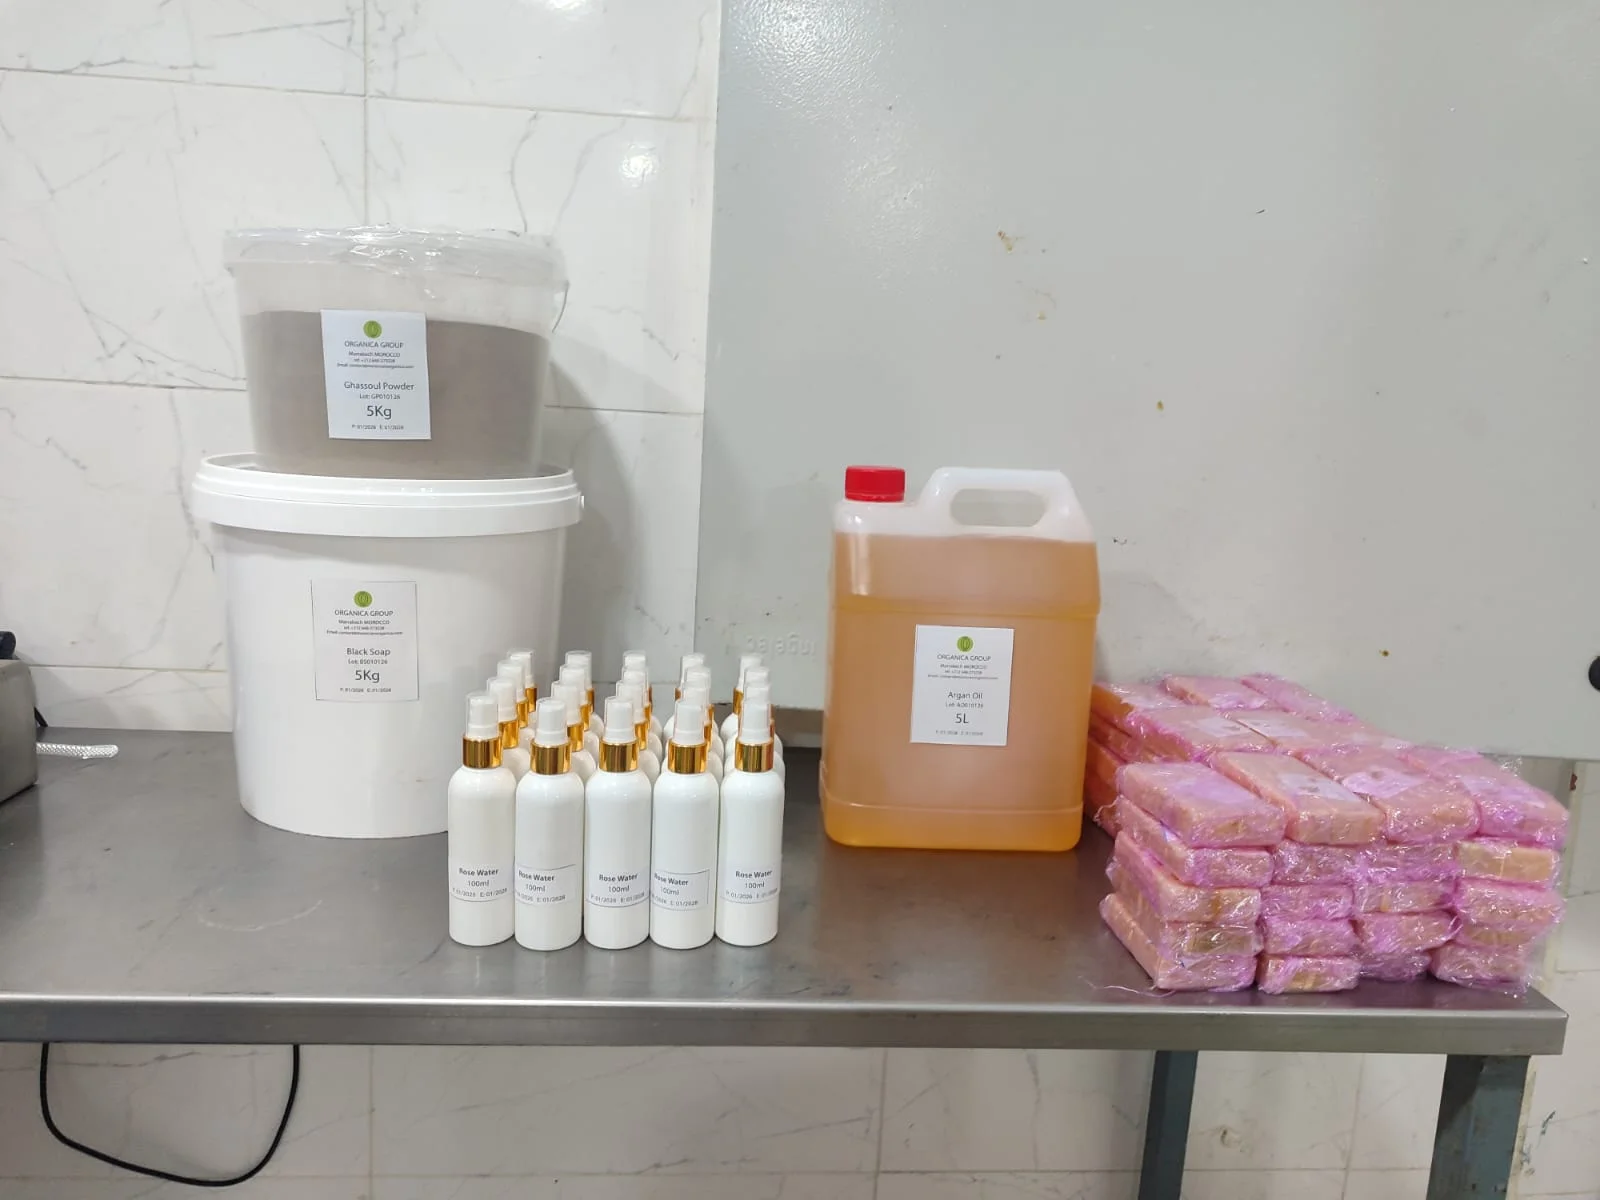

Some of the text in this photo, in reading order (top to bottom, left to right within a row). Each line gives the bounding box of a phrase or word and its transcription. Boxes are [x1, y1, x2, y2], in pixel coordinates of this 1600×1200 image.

[344, 381, 415, 391] Ghassoul Powder
[367, 405, 392, 420] 5Kg
[347, 648, 391, 657] Black Soap
[355, 669, 380, 684] 5Kg
[948, 691, 983, 701] Argan Oil
[955, 713, 969, 724] 5L
[459, 867, 499, 877] Rose Water
[519, 870, 532, 880] Rose
[736, 870, 773, 879] Rose Water
[599, 873, 638, 882] Rose Water
[654, 872, 689, 886] Rose Water
[526, 884, 546, 892] 100ml
[609, 885, 630, 893] 100ml
[661, 886, 680, 896] 100ml
